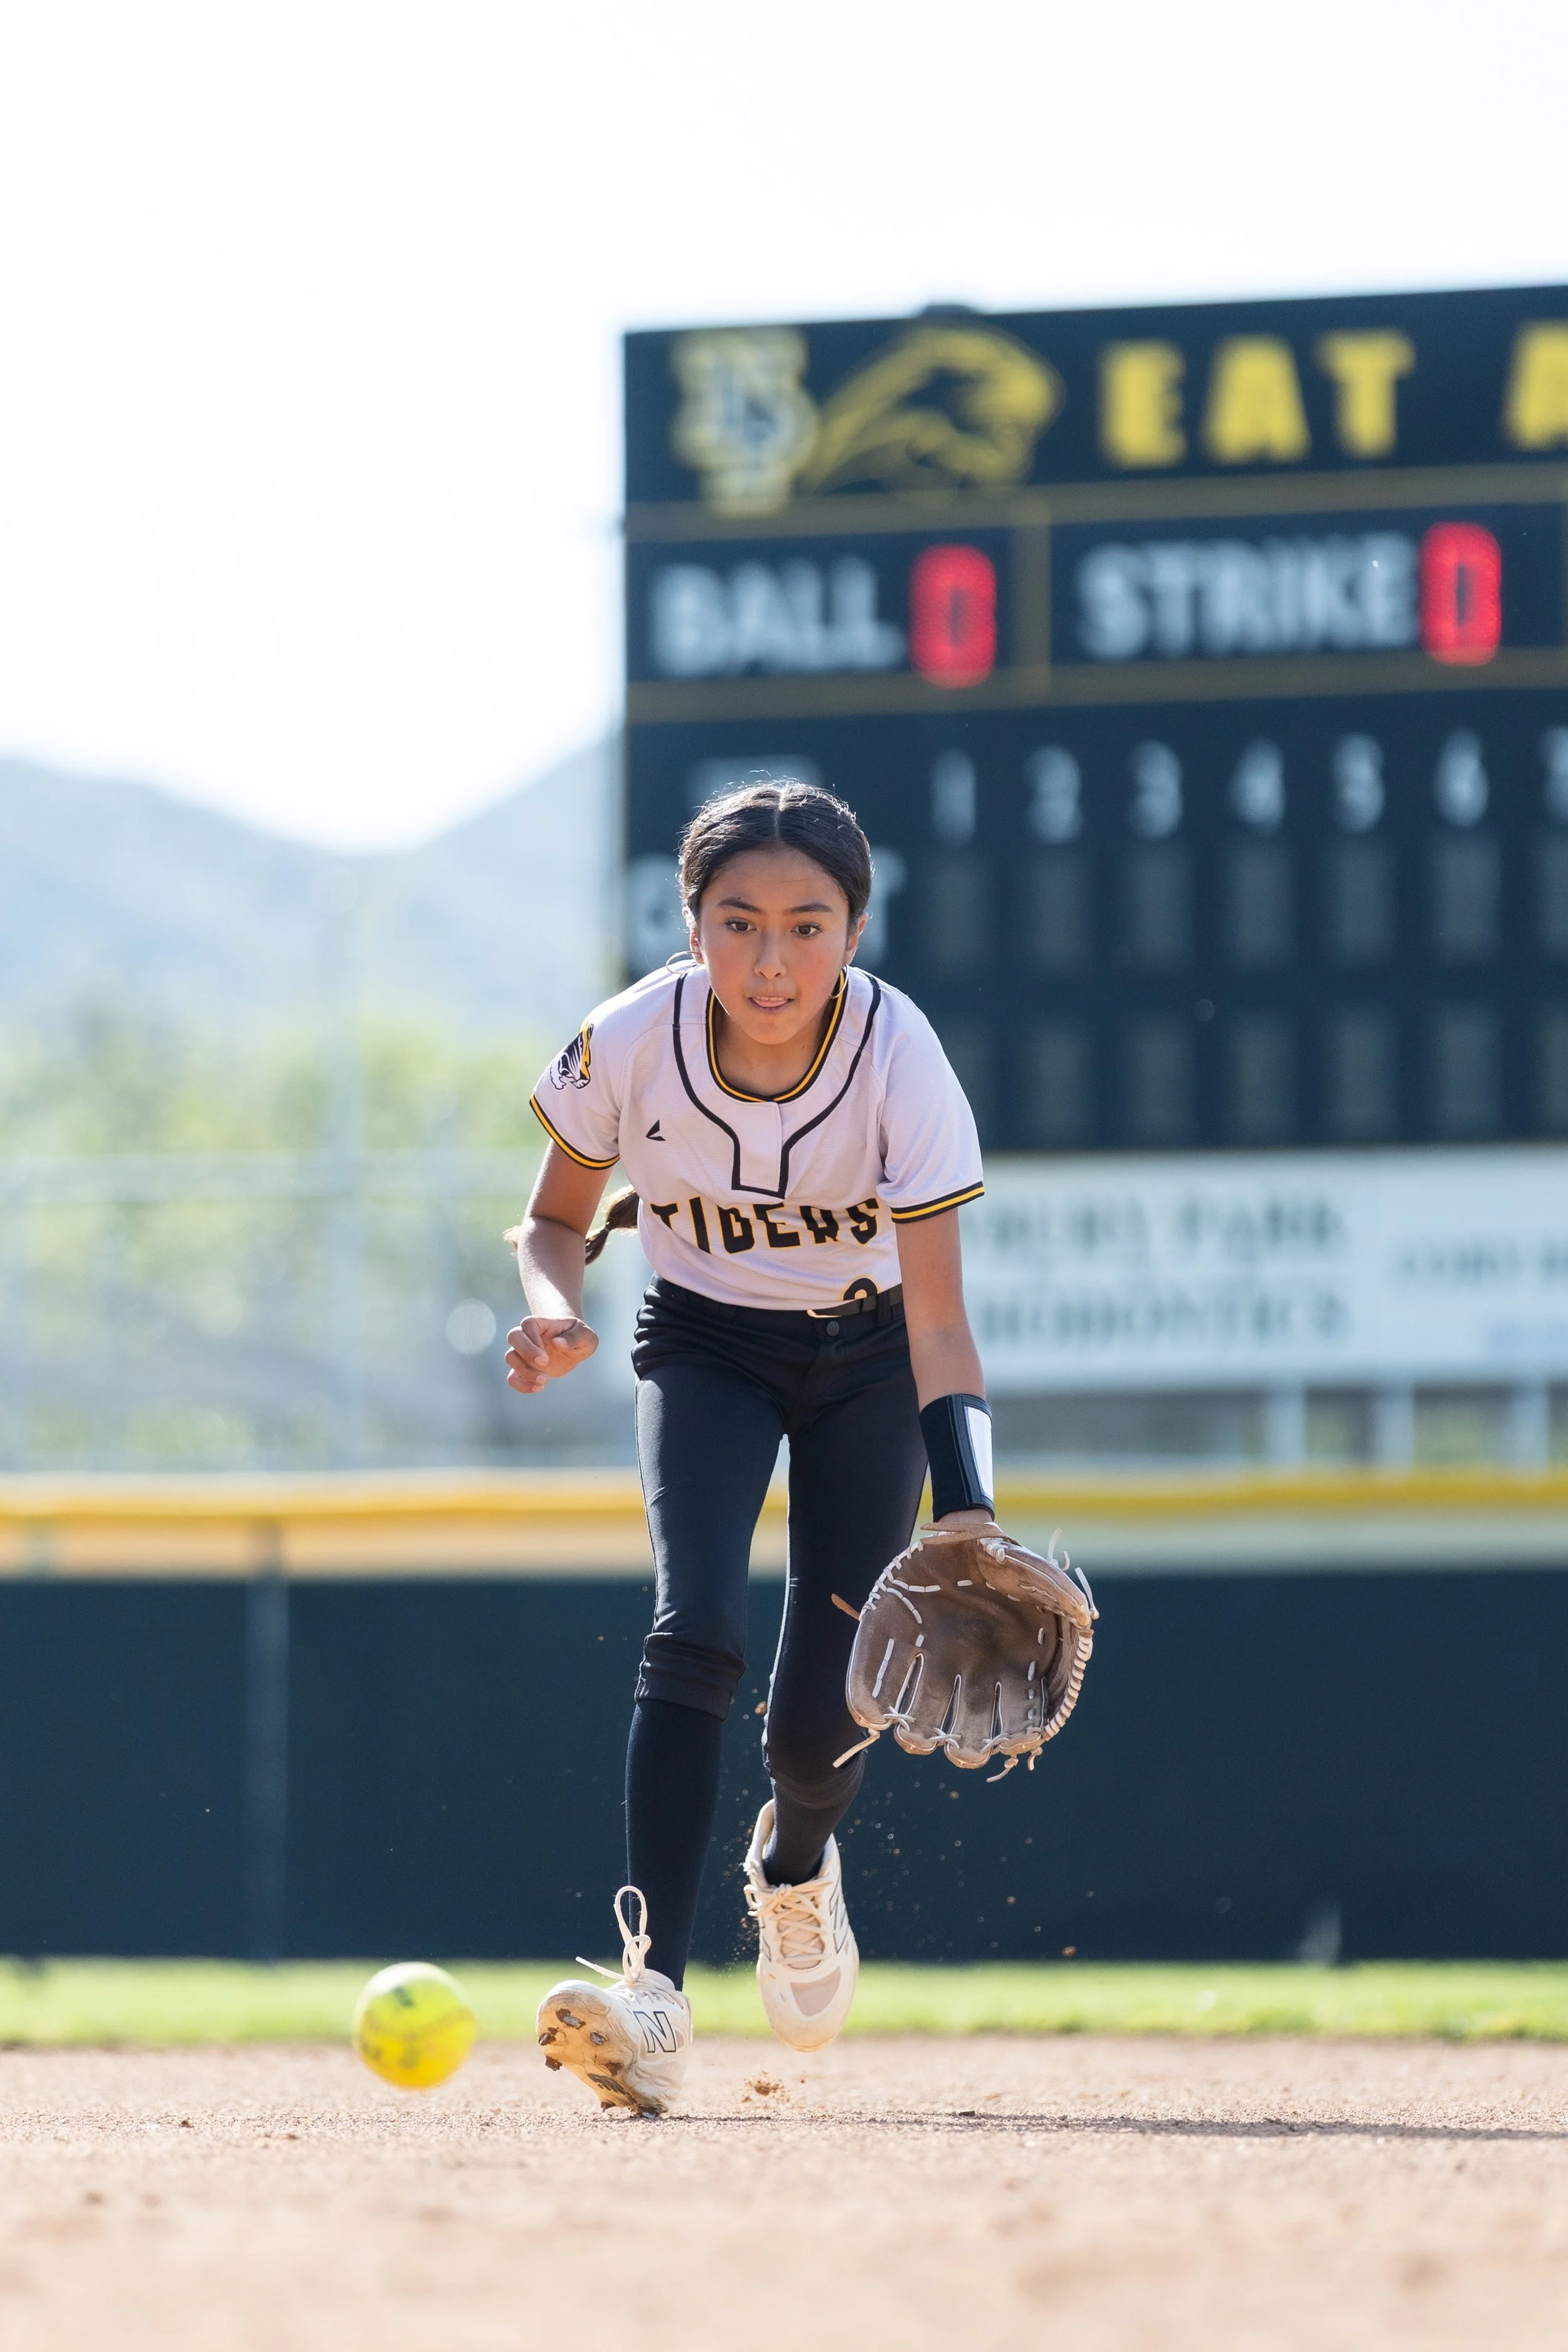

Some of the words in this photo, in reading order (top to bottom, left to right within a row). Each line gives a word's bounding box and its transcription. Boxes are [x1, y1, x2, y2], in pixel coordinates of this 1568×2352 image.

[1099, 332, 1414, 468] EAT
[654, 559, 902, 676] BALL
[909, 544, 996, 687] 0
[1080, 533, 1416, 661] STRIKE
[1420, 523, 1502, 666] 0
[932, 750, 976, 844] 1
[650, 1195, 879, 1255] TIGERS
